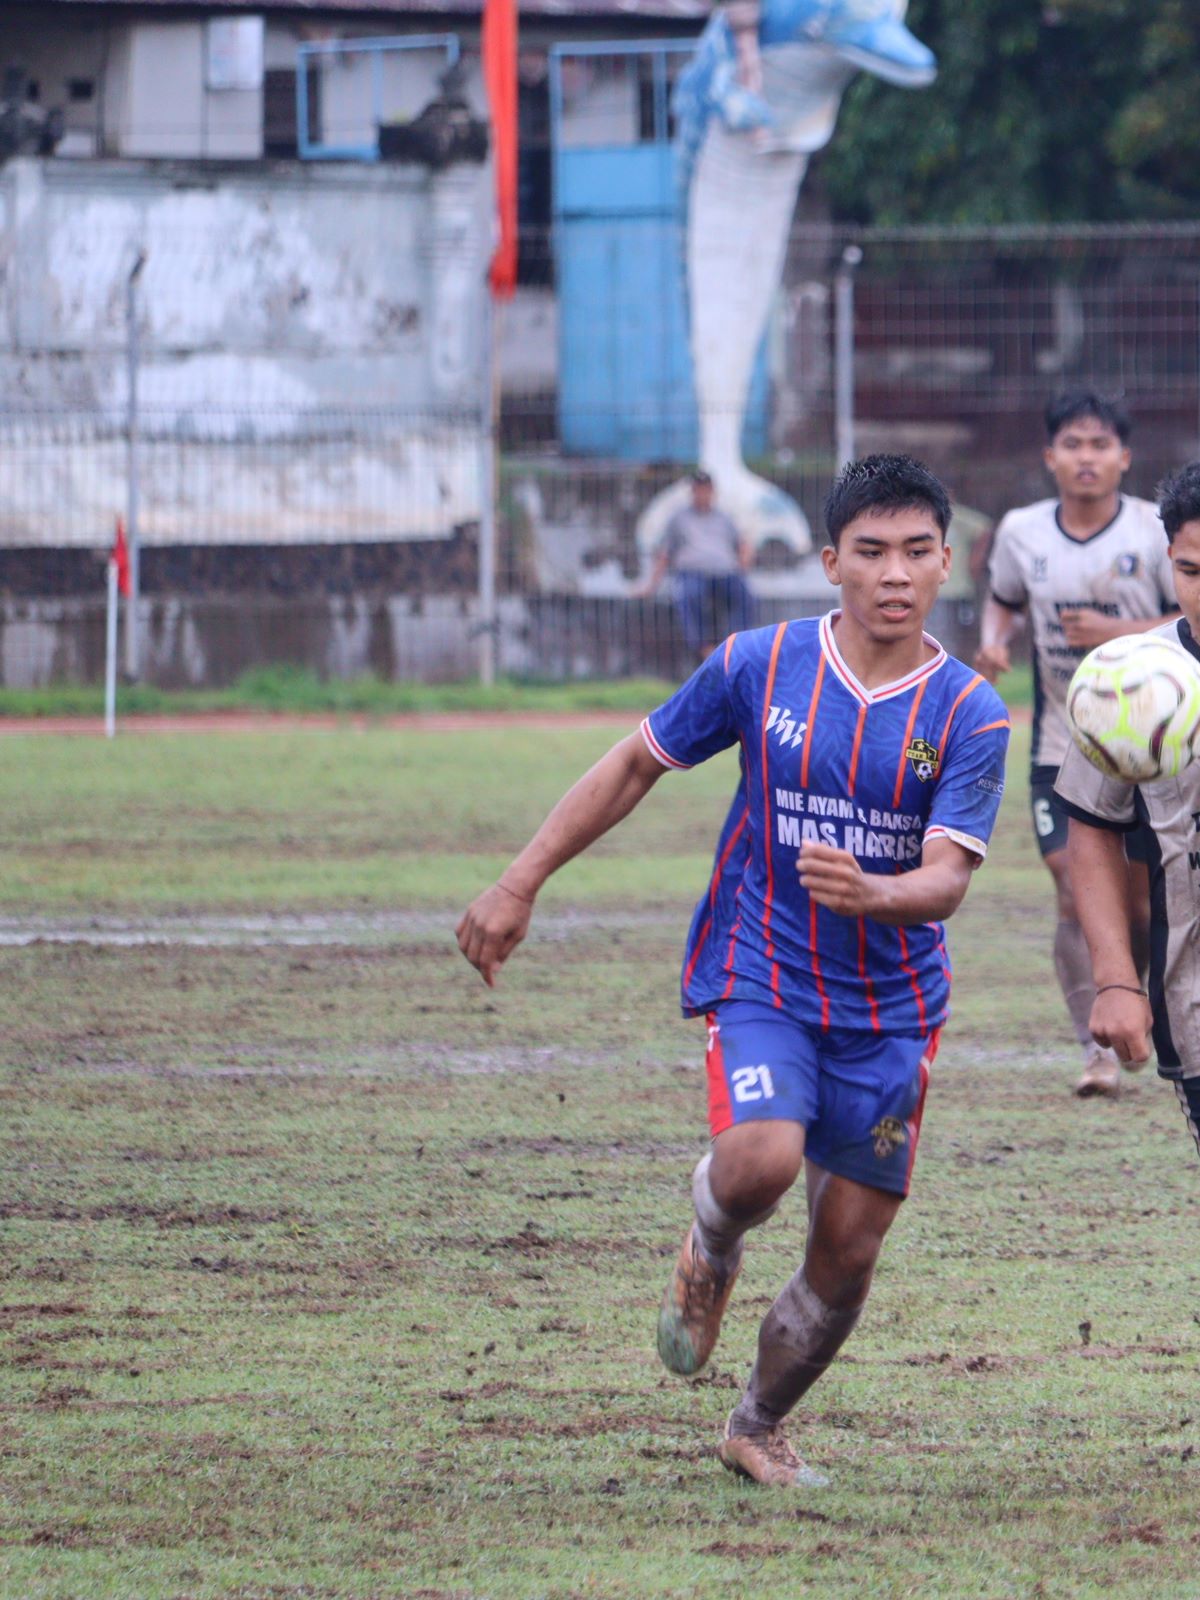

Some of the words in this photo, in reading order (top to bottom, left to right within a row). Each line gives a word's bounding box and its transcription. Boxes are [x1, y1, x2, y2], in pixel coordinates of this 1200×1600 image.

[977, 777, 1005, 793] RESPEC
[775, 788, 804, 811] MIE
[807, 795, 854, 819] AYAM
[857, 807, 867, 824] &
[1034, 798, 1054, 836] 6
[777, 813, 838, 851] MAS
[845, 825, 922, 861] HARIS
[731, 1064, 775, 1103] 21
